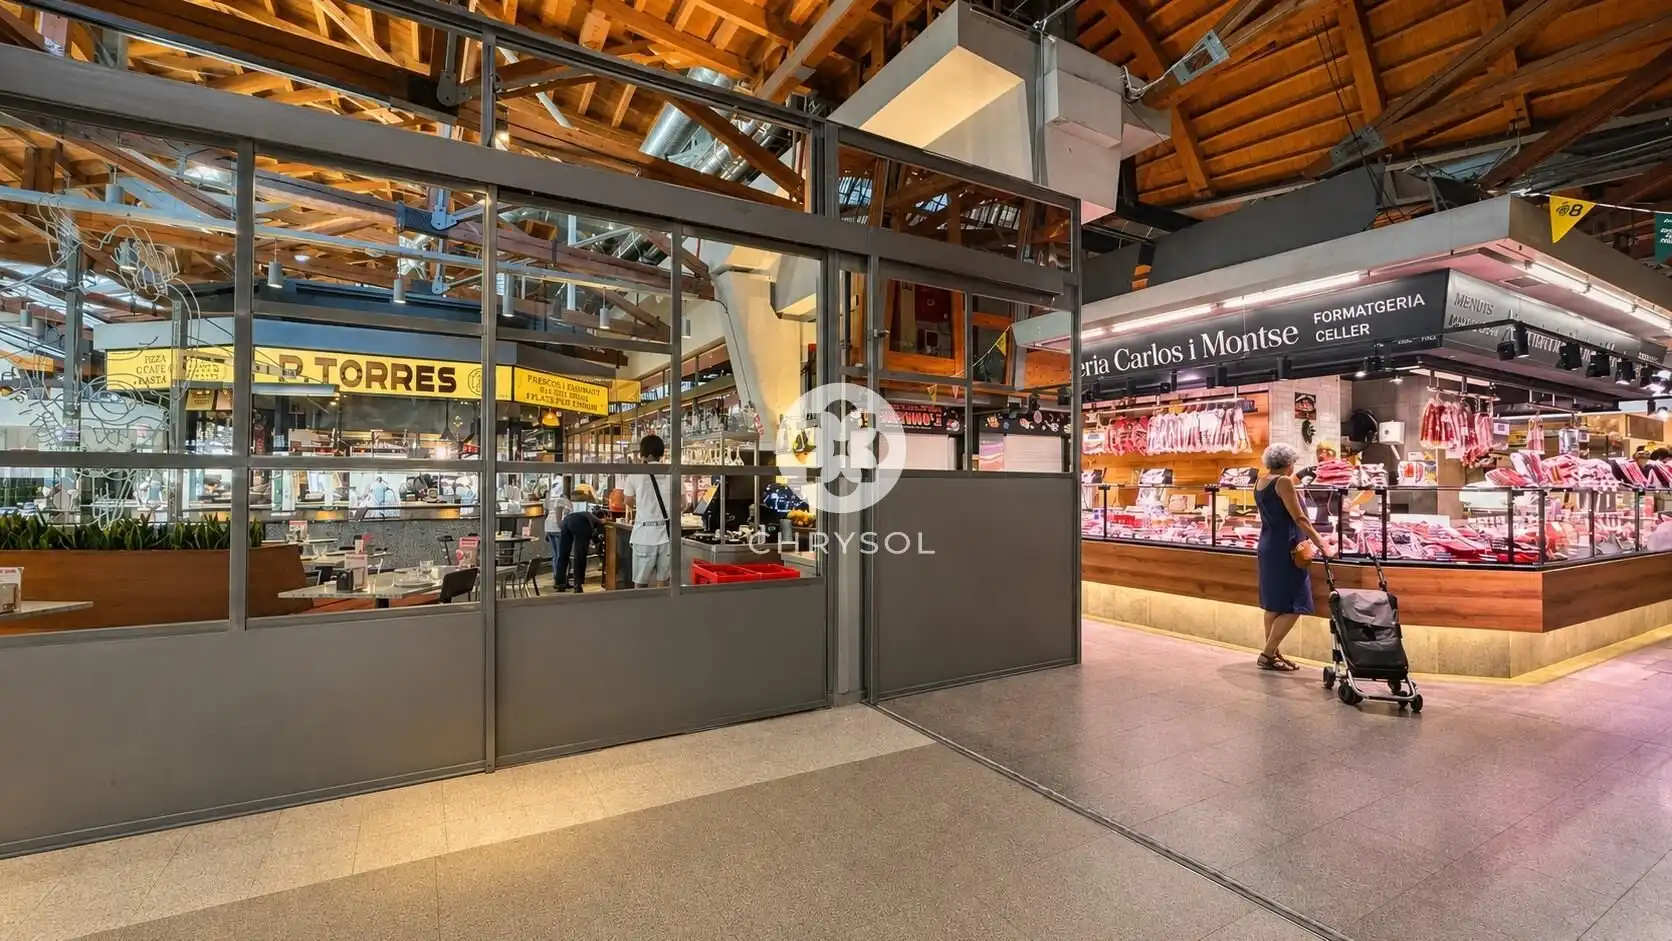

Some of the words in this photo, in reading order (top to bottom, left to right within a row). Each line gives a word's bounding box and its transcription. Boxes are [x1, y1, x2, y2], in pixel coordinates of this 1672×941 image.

[1313, 293, 1425, 324] FORMATGERIA
[1113, 342, 1184, 372] Carlos
[1188, 338, 1197, 360] i
[1200, 325, 1299, 358] Montse
[1315, 323, 1370, 342] CELLER
[314, 357, 457, 393] TORRES
